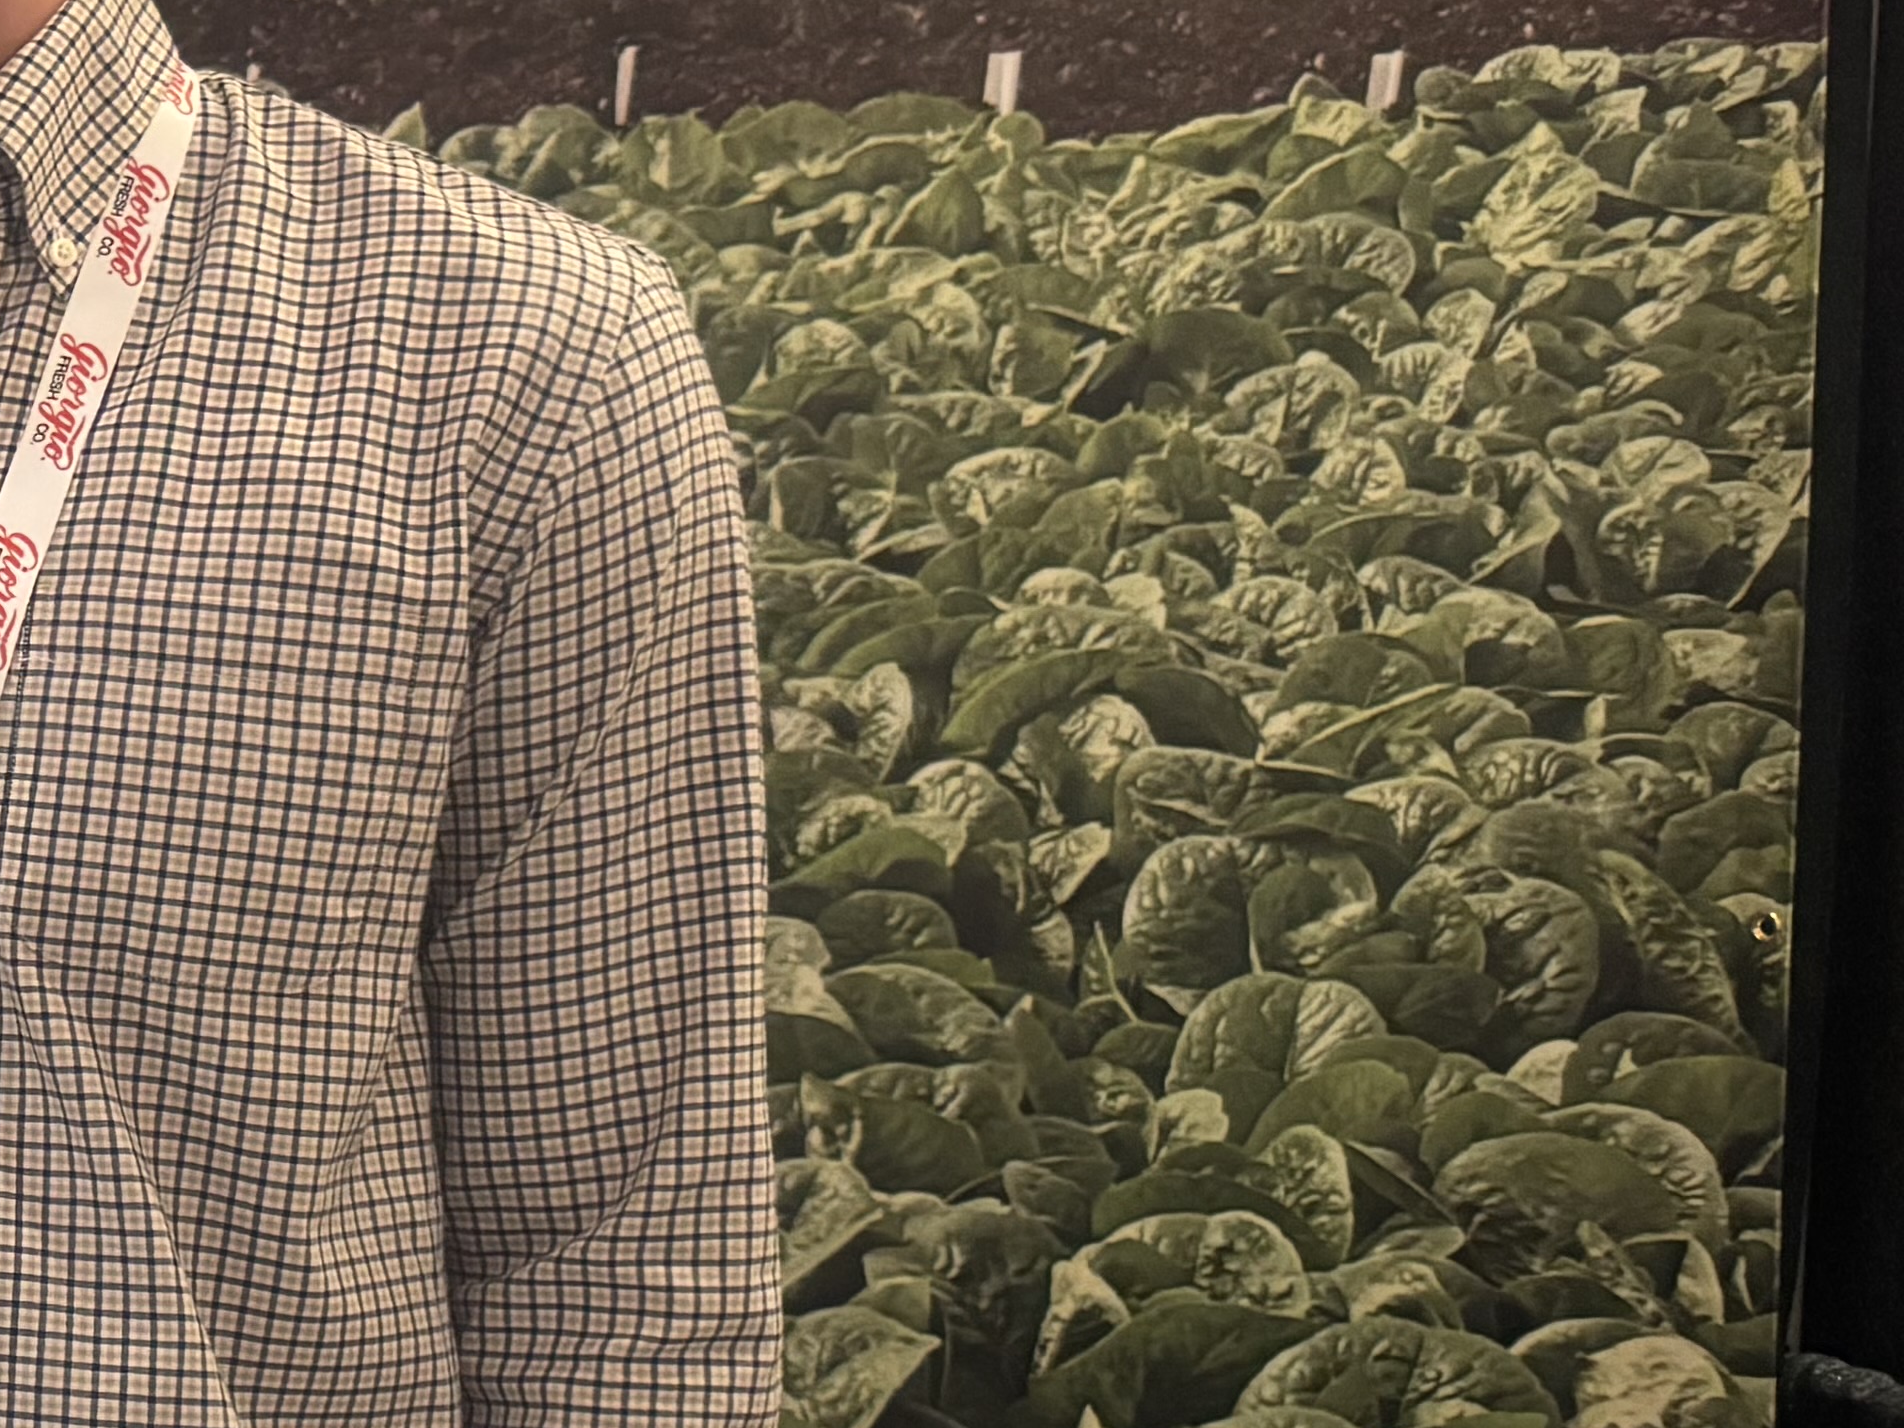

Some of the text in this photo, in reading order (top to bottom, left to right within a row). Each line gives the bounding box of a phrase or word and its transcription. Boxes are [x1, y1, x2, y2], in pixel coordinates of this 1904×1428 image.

[95, 175, 134, 259] FRESH CO.
[99, 156, 170, 287] Giorgio
[30, 355, 71, 445] FRESH CO.
[38, 333, 108, 471] Giorgio
